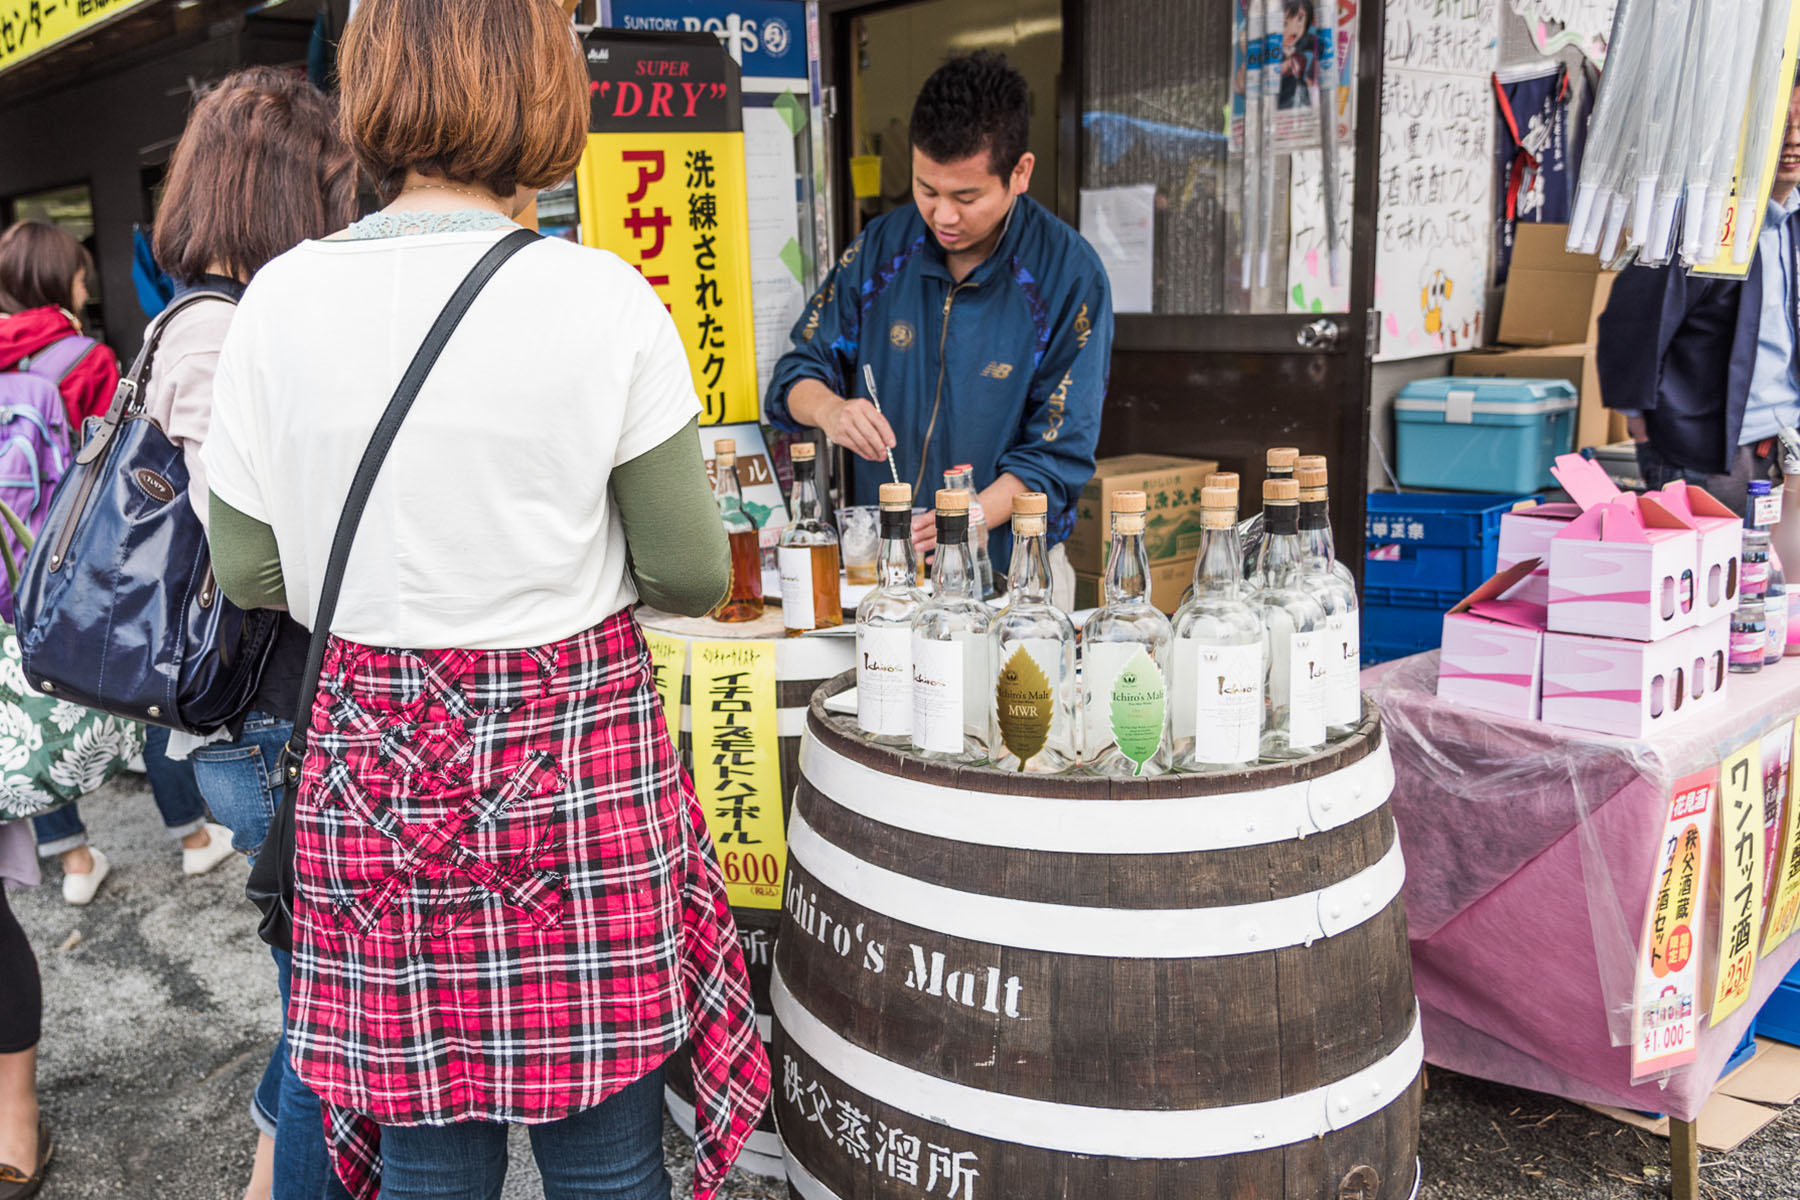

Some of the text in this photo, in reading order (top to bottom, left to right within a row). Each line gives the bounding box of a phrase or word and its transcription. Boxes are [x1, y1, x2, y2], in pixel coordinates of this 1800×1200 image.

[624, 15, 679, 31] SUNTORY
[682, 16, 758, 52] BOS
[635, 60, 690, 77] SUPER
[684, 149, 725, 425] 洗練されたクリ
[1008, 704, 1039, 717] MWR
[1029, 690, 1049, 700] Malt
[1112, 692, 1145, 702] Ichiro's
[708, 672, 762, 845] イチローズモルトハイボール
[724, 851, 779, 885] 600
[1728, 757, 1754, 960] ワンカップ酒
[1651, 834, 1678, 968] カップ酒セット
[904, 942, 1024, 1019] Malt
[782, 1054, 980, 1200] 秩父蒸溜所
